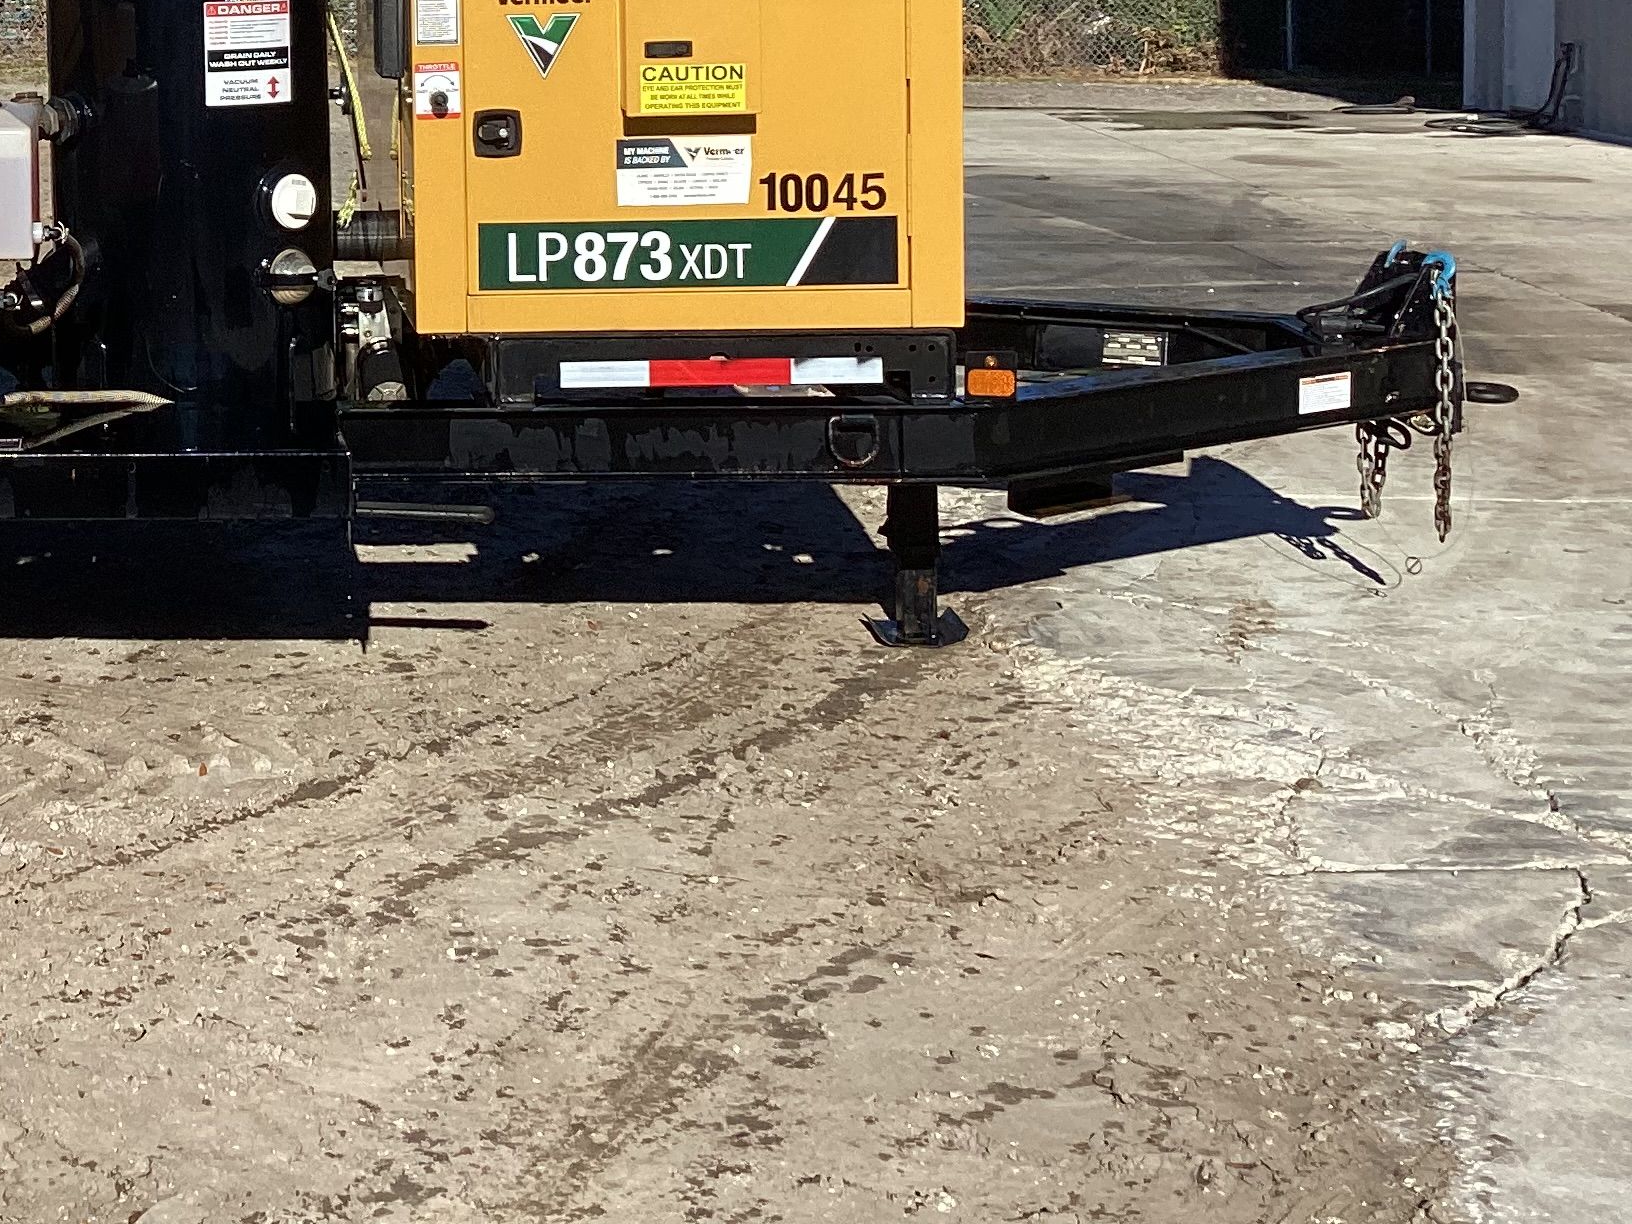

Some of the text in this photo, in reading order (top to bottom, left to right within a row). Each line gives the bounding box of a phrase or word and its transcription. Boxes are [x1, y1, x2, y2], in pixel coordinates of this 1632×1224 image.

[217, 4, 281, 15] DANGER
[223, 52, 252, 60] DRAIN
[238, 59, 256, 67] OUT
[257, 57, 287, 66] WEEKLY
[642, 65, 743, 82] CAUTION
[702, 101, 741, 109] EQUIPMENT
[623, 146, 670, 156] MY MACHINE
[624, 155, 671, 164] IS BACKED BY
[759, 172, 887, 212] 10045
